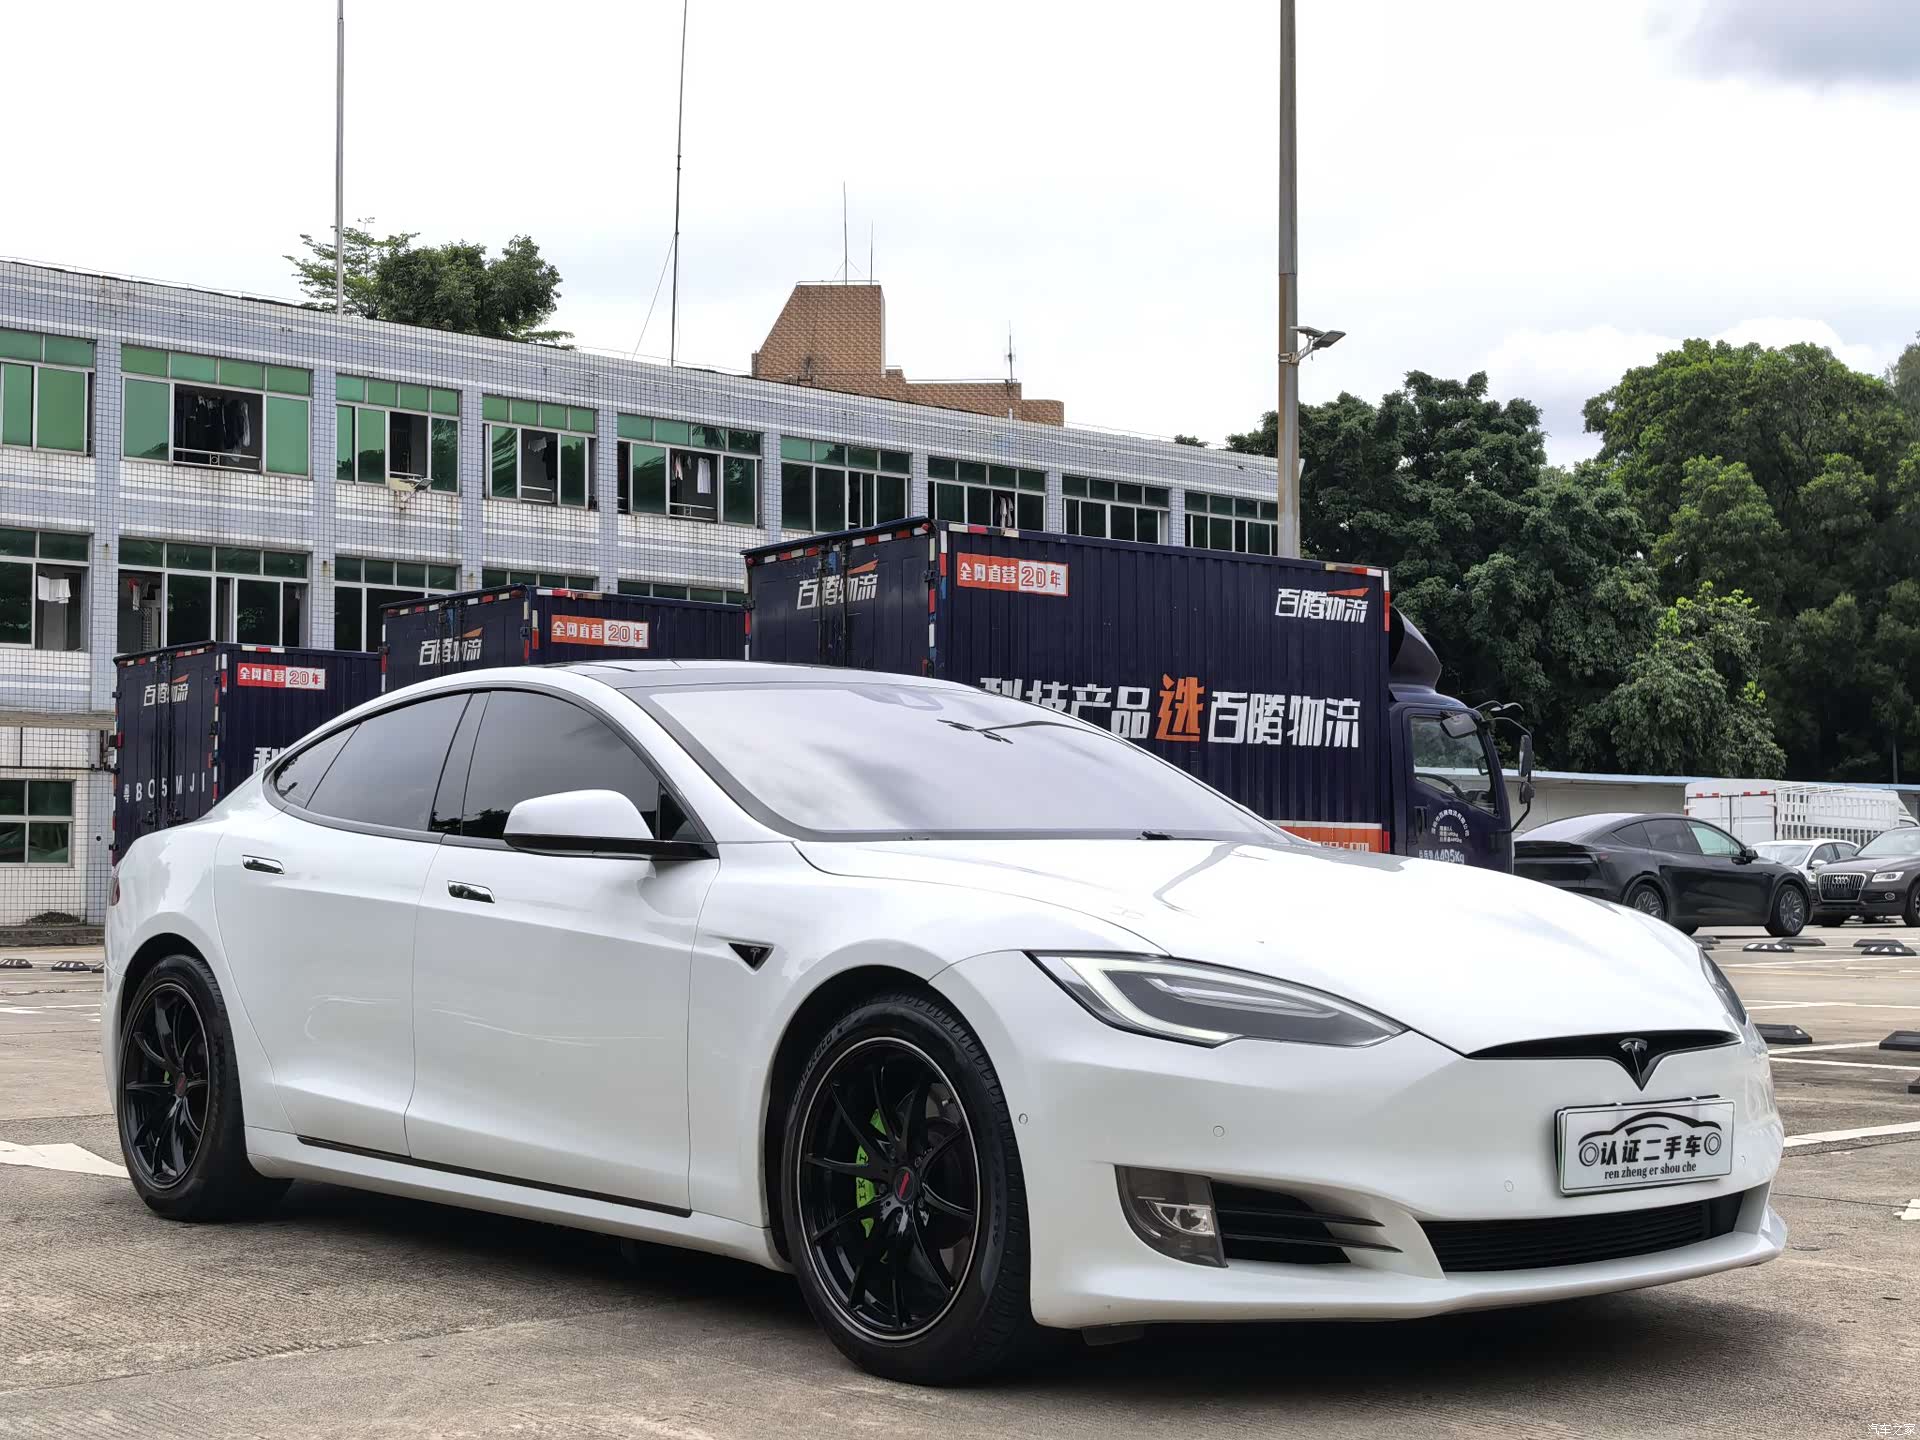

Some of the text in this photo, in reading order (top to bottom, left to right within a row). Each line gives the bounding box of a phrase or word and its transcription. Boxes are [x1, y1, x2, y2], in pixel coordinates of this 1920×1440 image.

[1275, 588, 1369, 623] 百腾物流
[1600, 1135, 1702, 1166] 认证二手车
[1604, 1161, 1697, 1180] ren zheng er shou che
